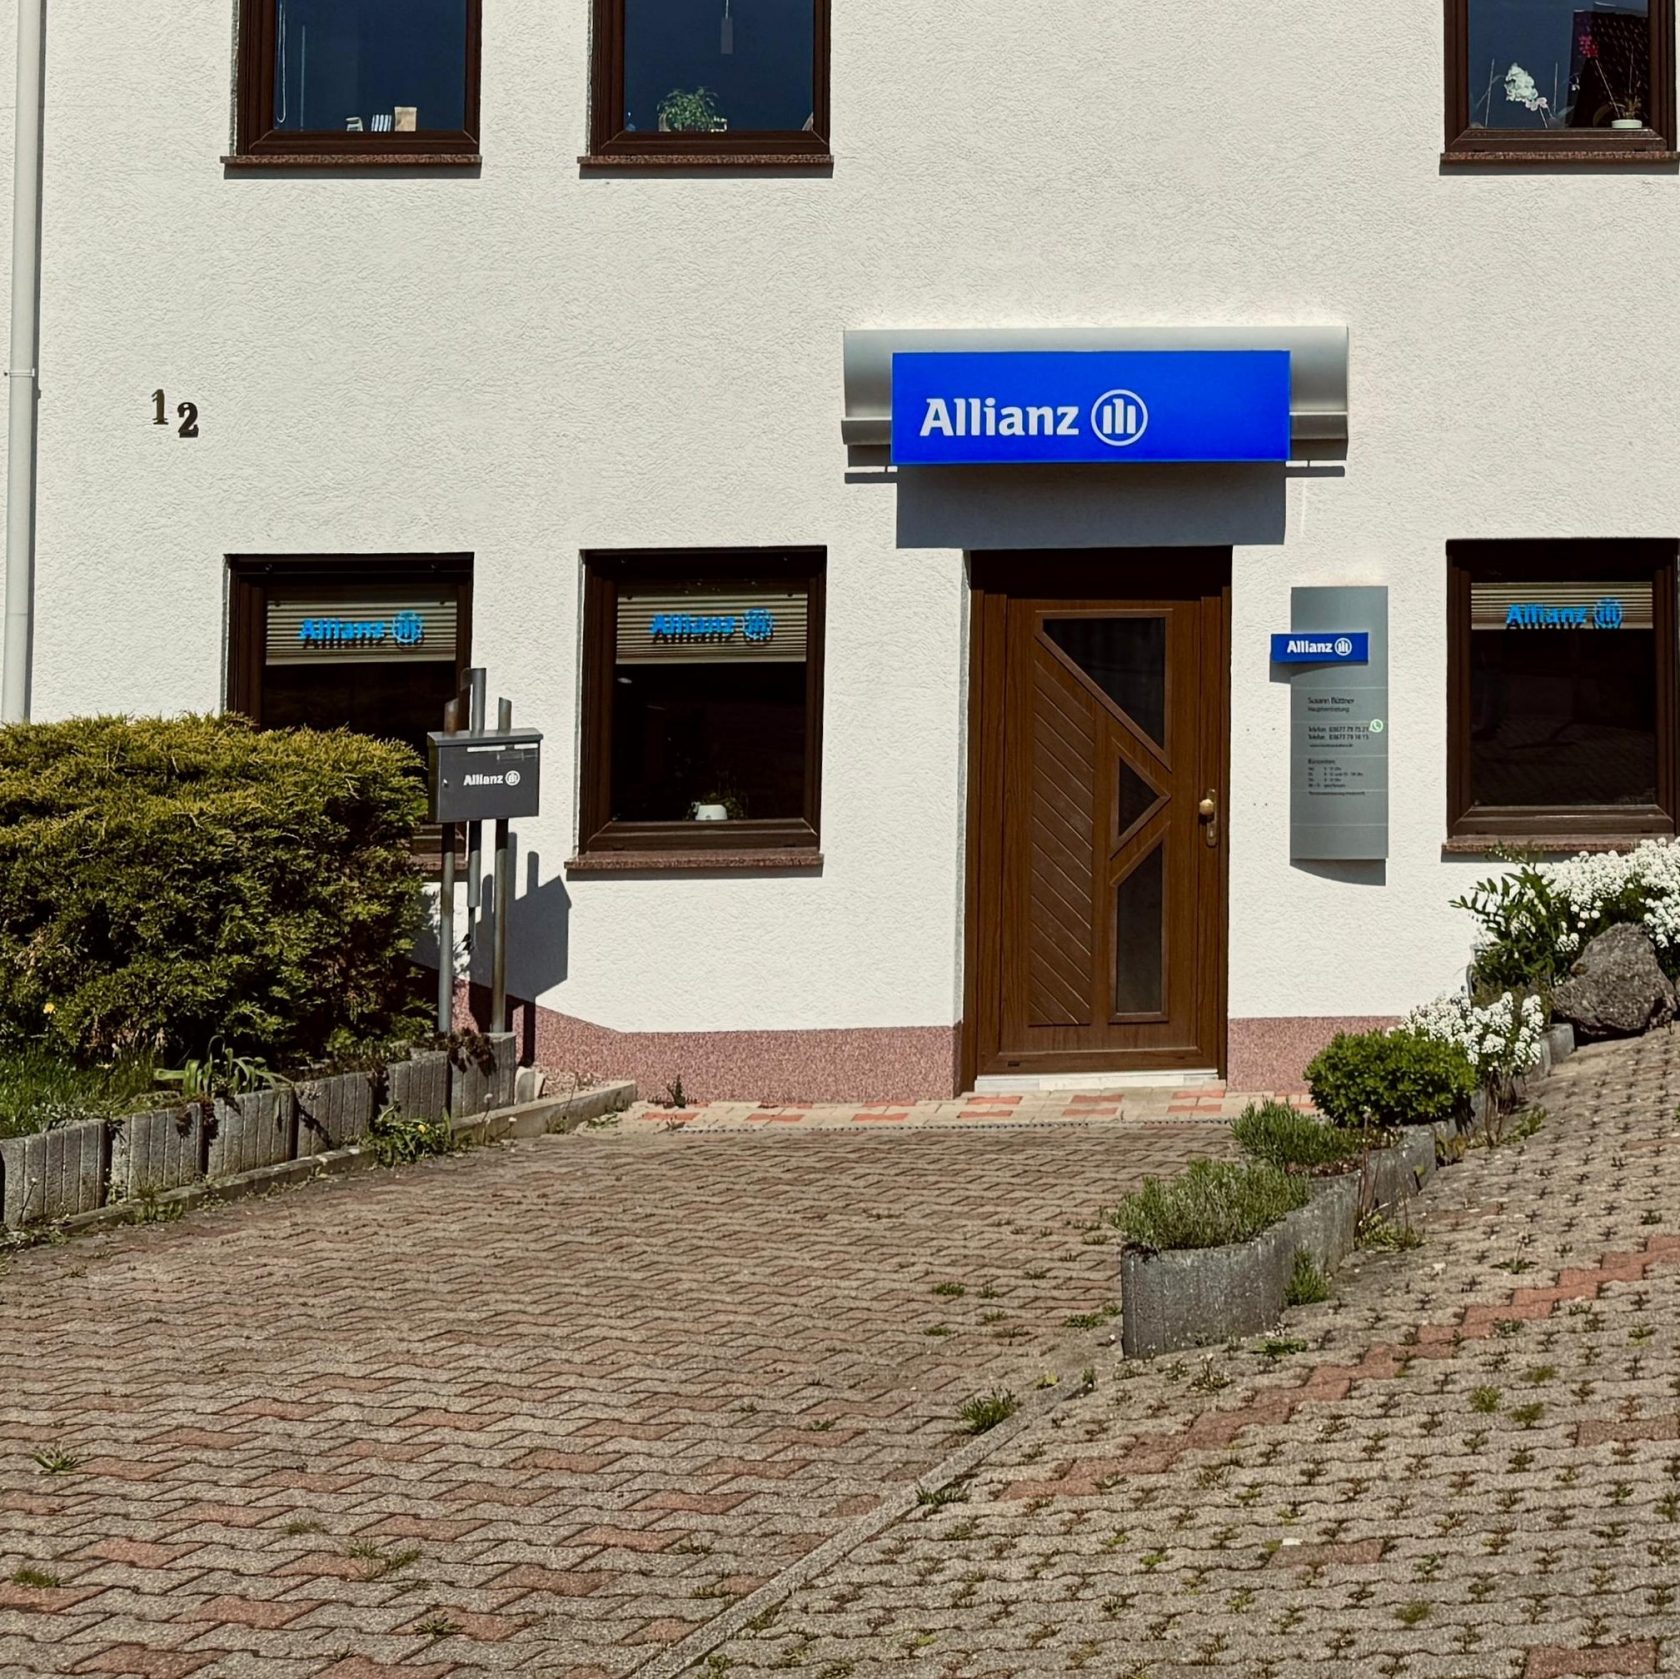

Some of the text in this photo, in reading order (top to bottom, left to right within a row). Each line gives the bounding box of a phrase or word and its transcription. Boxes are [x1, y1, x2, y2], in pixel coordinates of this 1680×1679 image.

[151, 388, 199, 438] 12
[919, 397, 1080, 437] Allianz
[649, 613, 736, 635] Allianz
[1506, 604, 1588, 624] Allianz
[297, 617, 386, 640] Allianz
[1286, 639, 1334, 654] Allianz
[463, 773, 505, 787] Allianz
